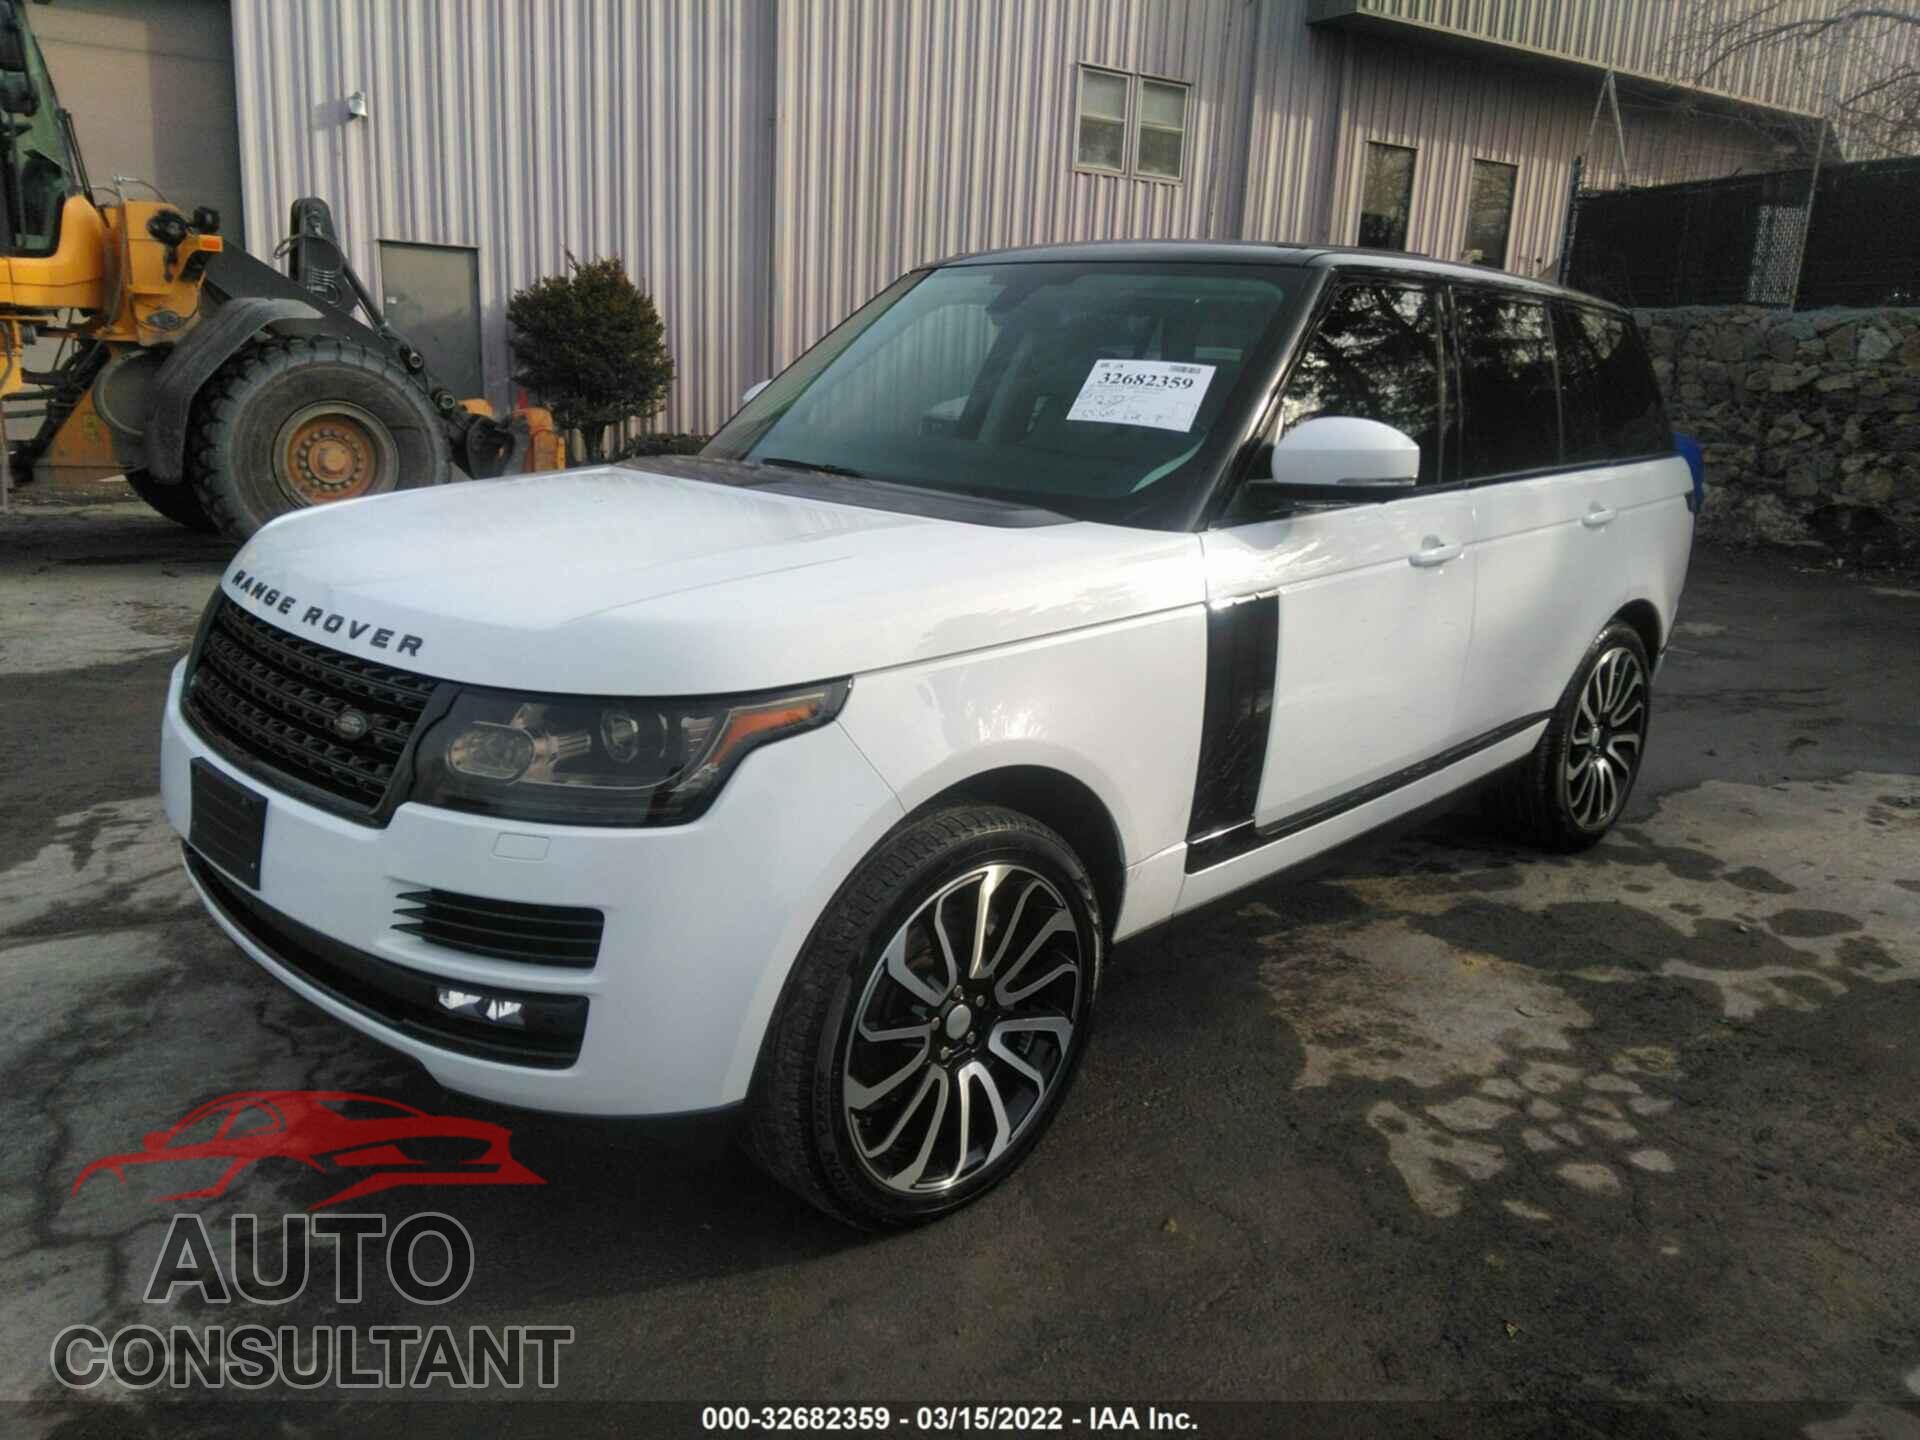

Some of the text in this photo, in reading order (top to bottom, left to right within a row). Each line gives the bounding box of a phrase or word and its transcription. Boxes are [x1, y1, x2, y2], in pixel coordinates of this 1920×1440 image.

[1097, 372, 1194, 390] 32682359
[231, 569, 424, 657] RANGE ROVER
